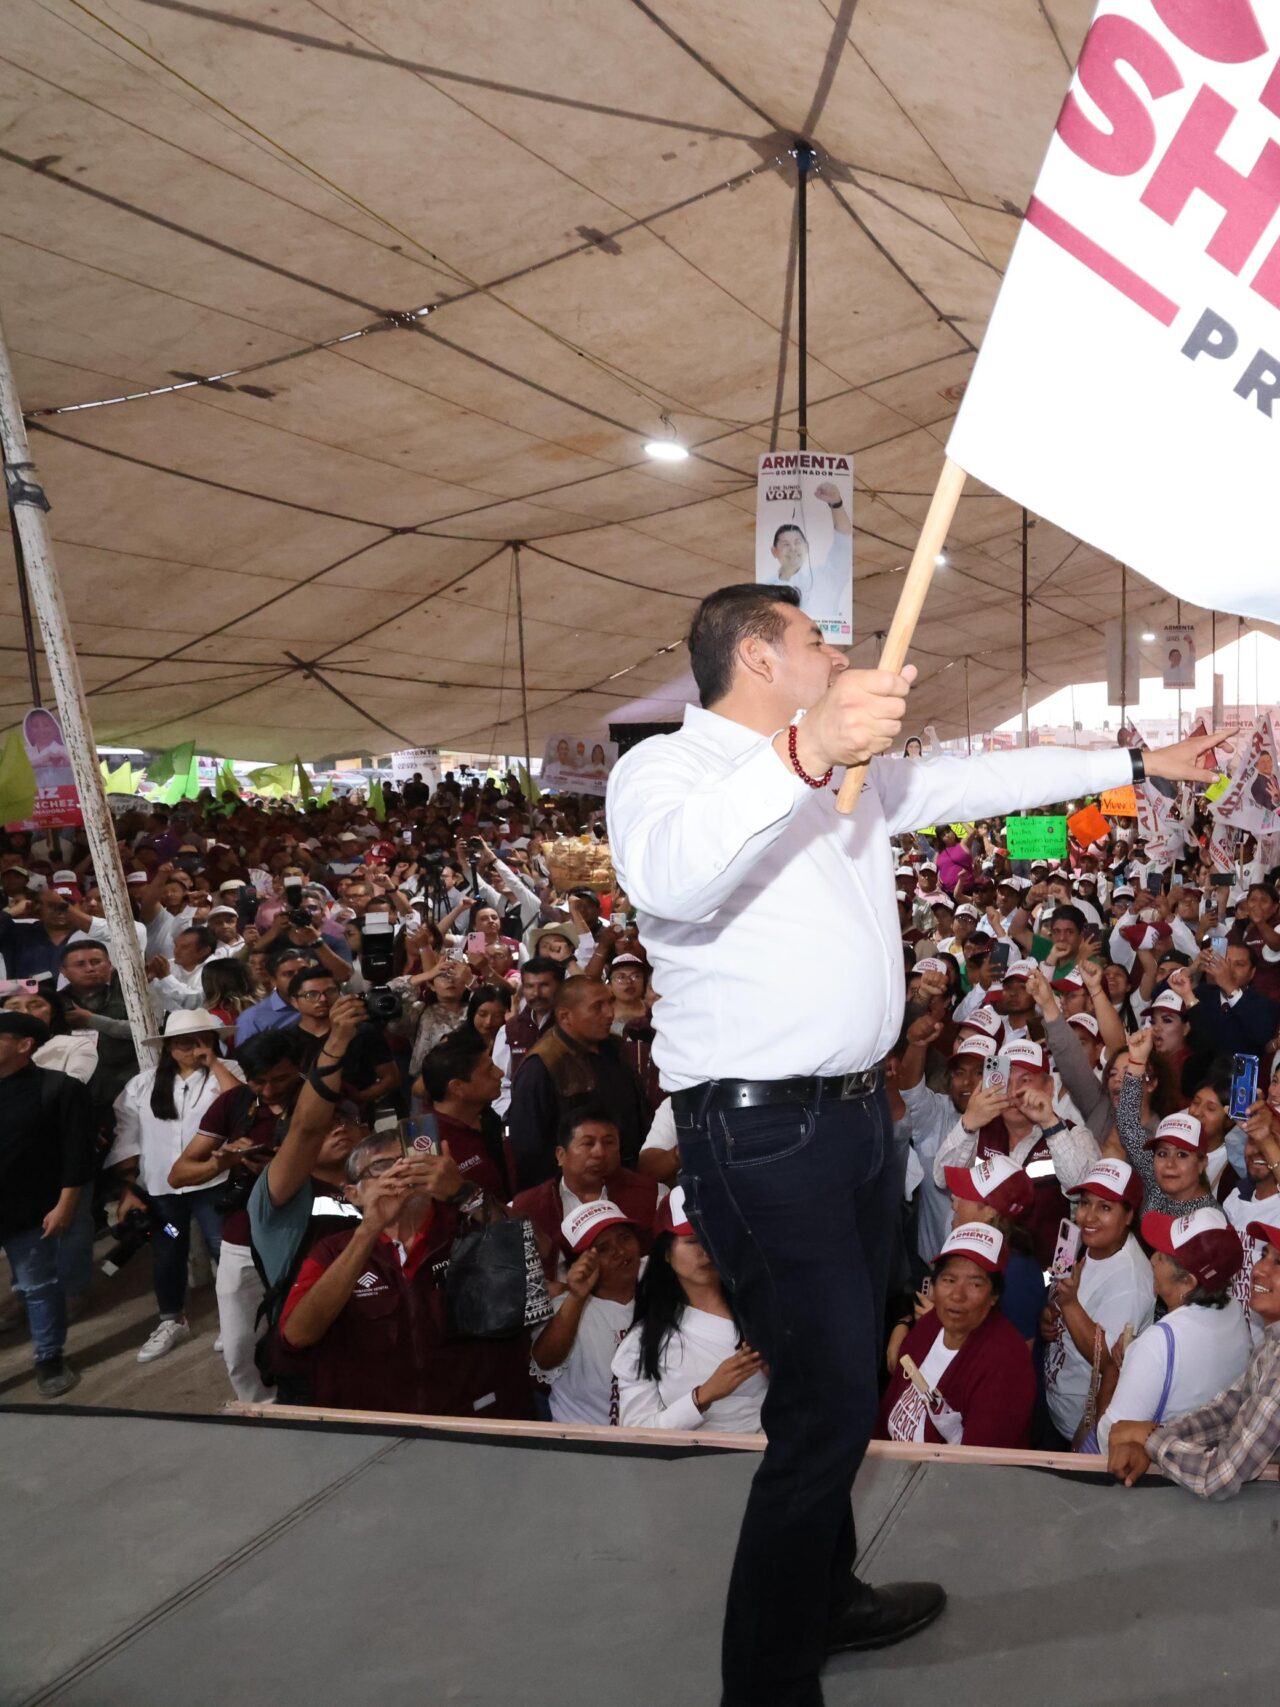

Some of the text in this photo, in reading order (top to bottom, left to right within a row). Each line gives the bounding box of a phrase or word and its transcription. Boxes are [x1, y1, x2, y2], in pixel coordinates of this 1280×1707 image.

[761, 455, 850, 470] ARMENTA
[572, 1206, 613, 1233] ARMENTA
[951, 1230, 994, 1244] ARMENTA
